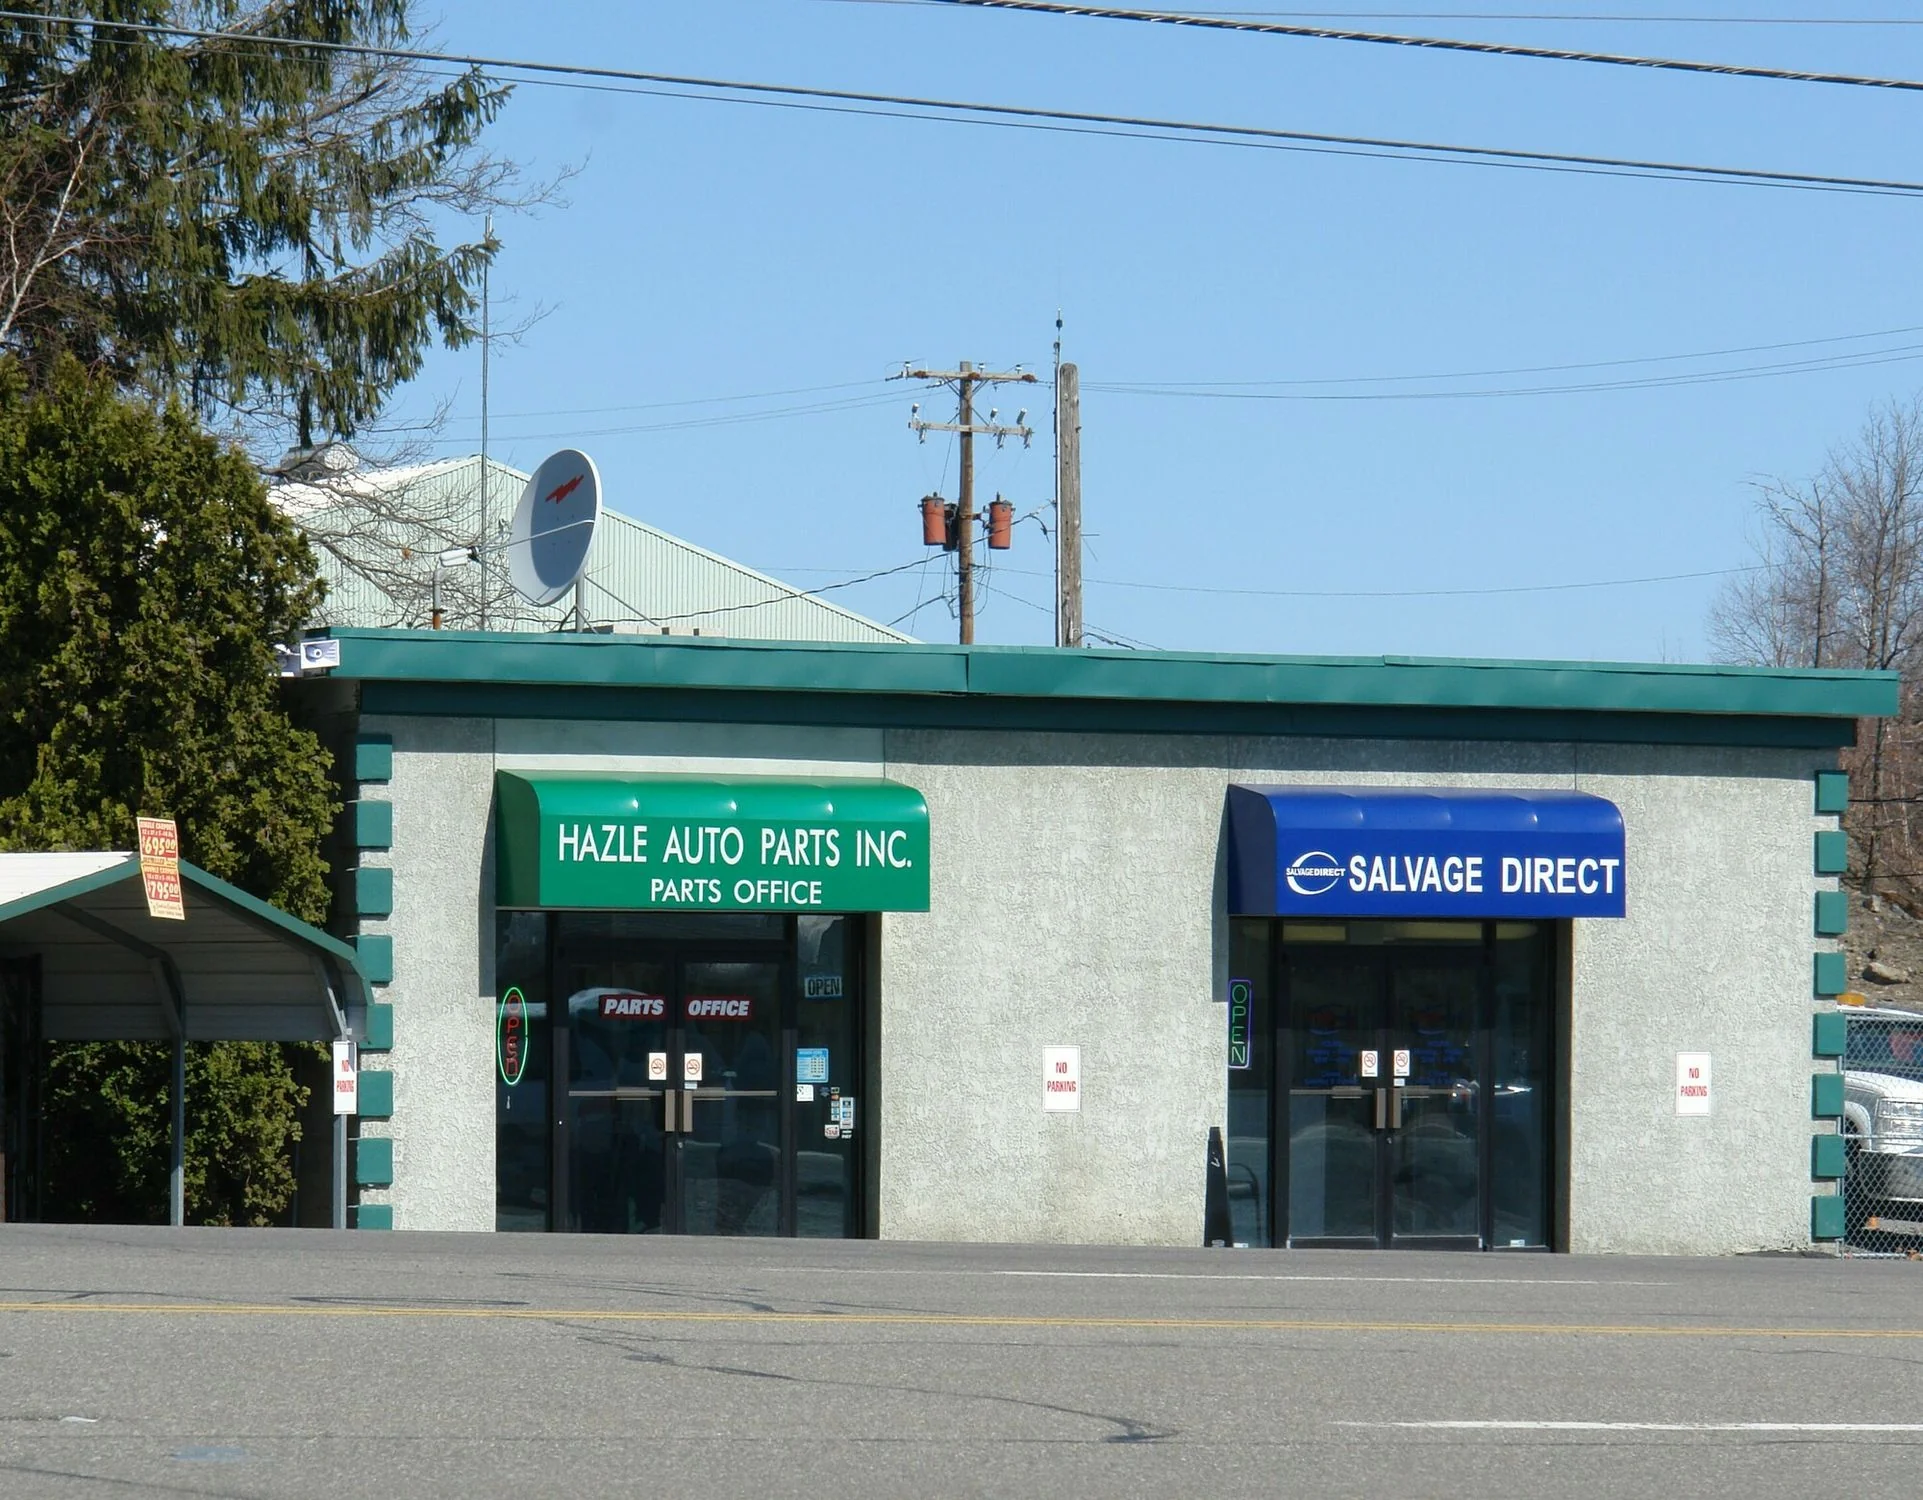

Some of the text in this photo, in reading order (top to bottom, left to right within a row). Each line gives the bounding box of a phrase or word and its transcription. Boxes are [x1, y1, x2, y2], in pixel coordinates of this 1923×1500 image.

[558, 823, 913, 868] HAZLE AUTO PARTS INC.
[1349, 855, 1620, 894] SALVAGE DIRECT
[650, 878, 822, 905] PARTS OFFICE
[807, 979, 840, 996] OPEN
[604, 999, 750, 1017] PARTS OFFICE
[1231, 984, 1248, 1064] OPEN
[1055, 1062, 1067, 1073] NO
[1689, 1067, 1699, 1078] NO
[1047, 1081, 1076, 1092] PARKING
[1680, 1086, 1707, 1096] PARKING
